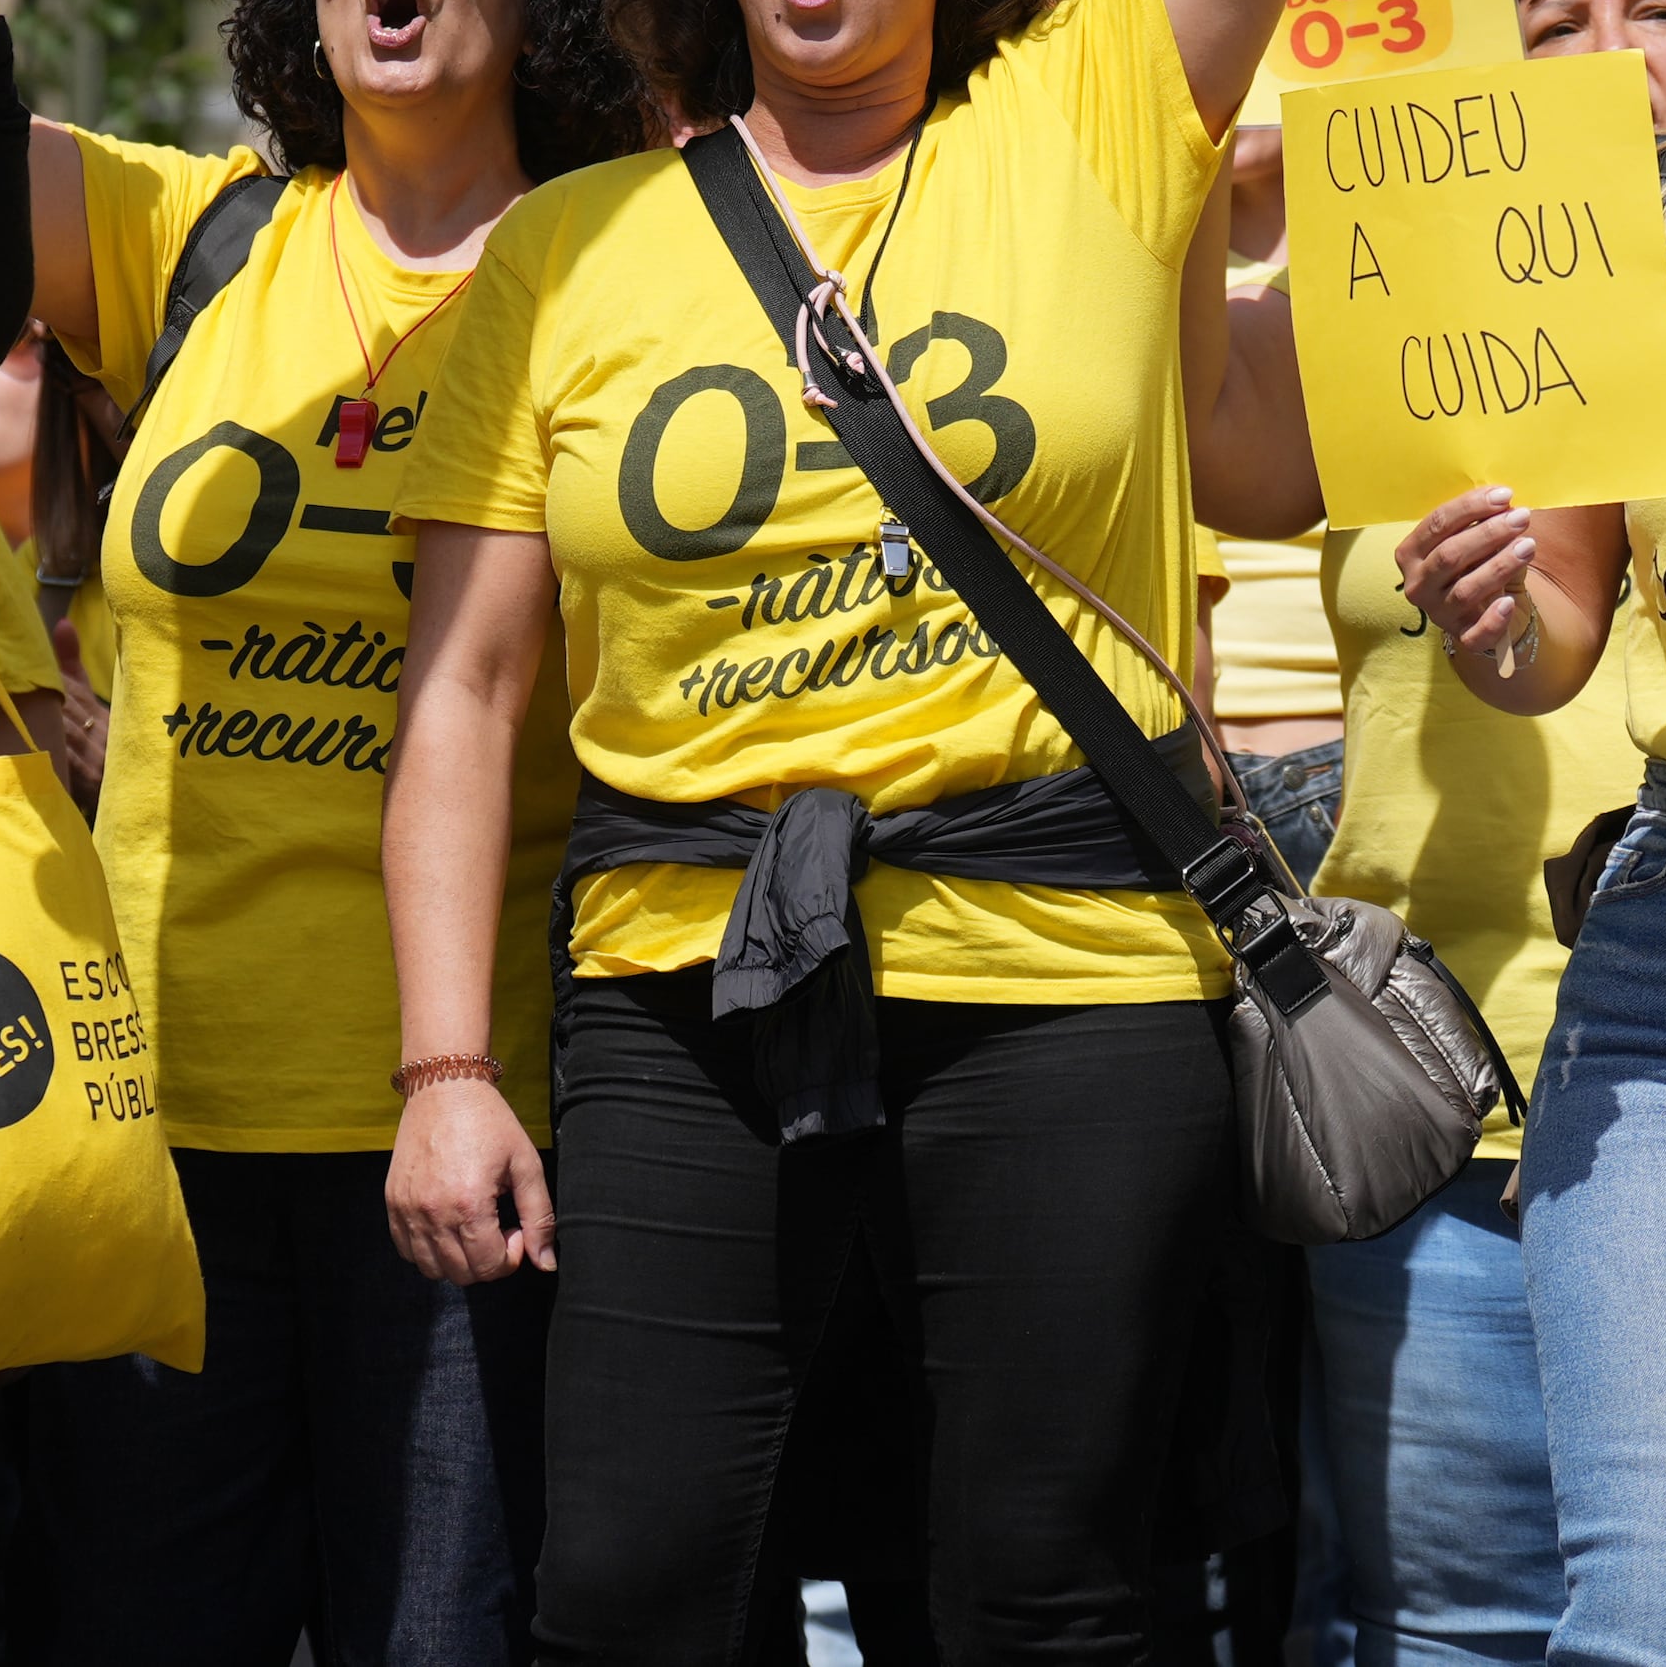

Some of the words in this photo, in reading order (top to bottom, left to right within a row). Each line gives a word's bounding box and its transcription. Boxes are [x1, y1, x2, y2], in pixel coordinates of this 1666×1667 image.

[1325, 91, 1527, 195] CUIDEU
[1348, 220, 1390, 301] A
[1497, 200, 1614, 284] QUI
[1401, 326, 1587, 422] CUIDA
[618, 310, 1037, 562] 0-3
[131, 420, 416, 602] 0-
